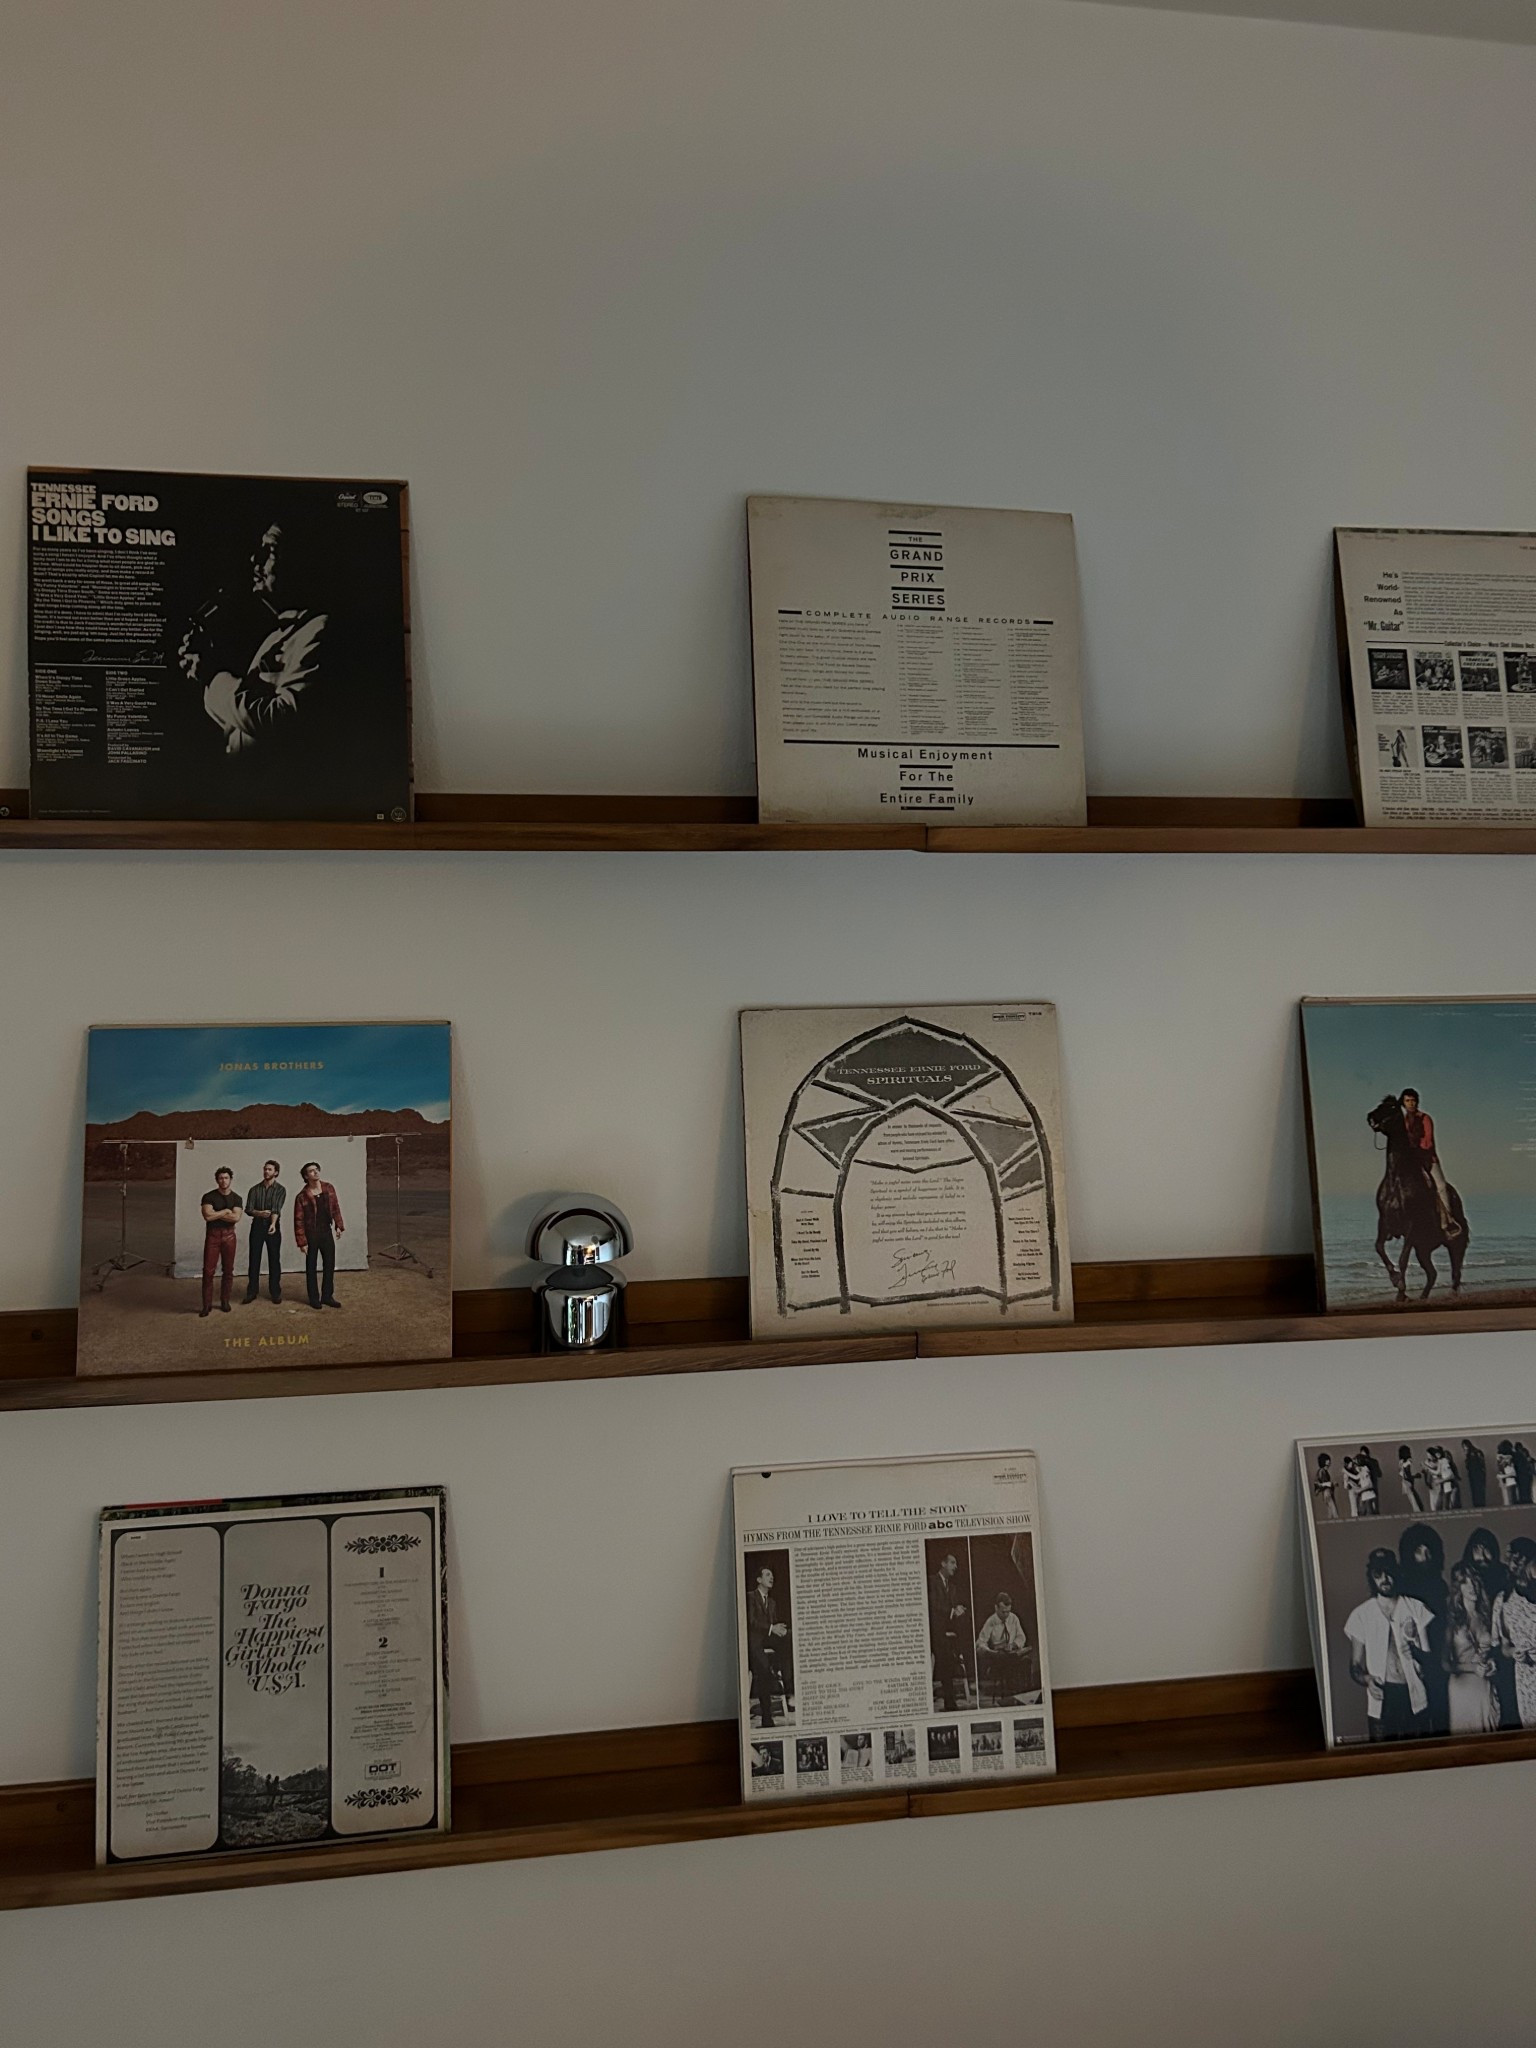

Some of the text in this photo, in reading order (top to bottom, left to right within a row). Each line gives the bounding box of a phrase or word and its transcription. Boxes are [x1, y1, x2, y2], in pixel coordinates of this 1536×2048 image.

[31, 483, 96, 493] TENNESSEE
[31, 492, 159, 512] ERNIE FORD
[32, 509, 106, 527] SONGS
[32, 525, 176, 546] I LIKE TO SING
[890, 549, 943, 562] GRAND
[901, 572, 935, 583] PRIX
[892, 593, 946, 605] SERIES
[806, 610, 872, 620] COMPLETE
[979, 617, 1031, 625] RECORDS
[858, 748, 993, 762] Musical Enjoyment
[900, 771, 954, 782] For The
[880, 793, 975, 806] Entire Family
[219, 1062, 324, 1071] JONAS BROTHERS
[837, 1064, 981, 1076] TENNESSEE ERNIE FORD
[867, 1074, 953, 1086] SPIRITUALS
[224, 1335, 309, 1348] THE ALBUM
[808, 1504, 968, 1523] I LOVE TO TELL THE STORY
[743, 1514, 1031, 1543] HYMNS FROM THE TENNESSEE ERNIE FORD abc TELEVISION SHOW
[241, 1584, 310, 1600] Donna
[244, 1597, 307, 1616] Fargo
[259, 1612, 297, 1630] The
[235, 1624, 325, 1648] Happiest
[379, 1637, 388, 1648] 2
[225, 1638, 325, 1668] Girl in The
[241, 1656, 307, 1676] Whole
[248, 1673, 306, 1695] U.S.A.
[369, 1763, 397, 1773] DOT
